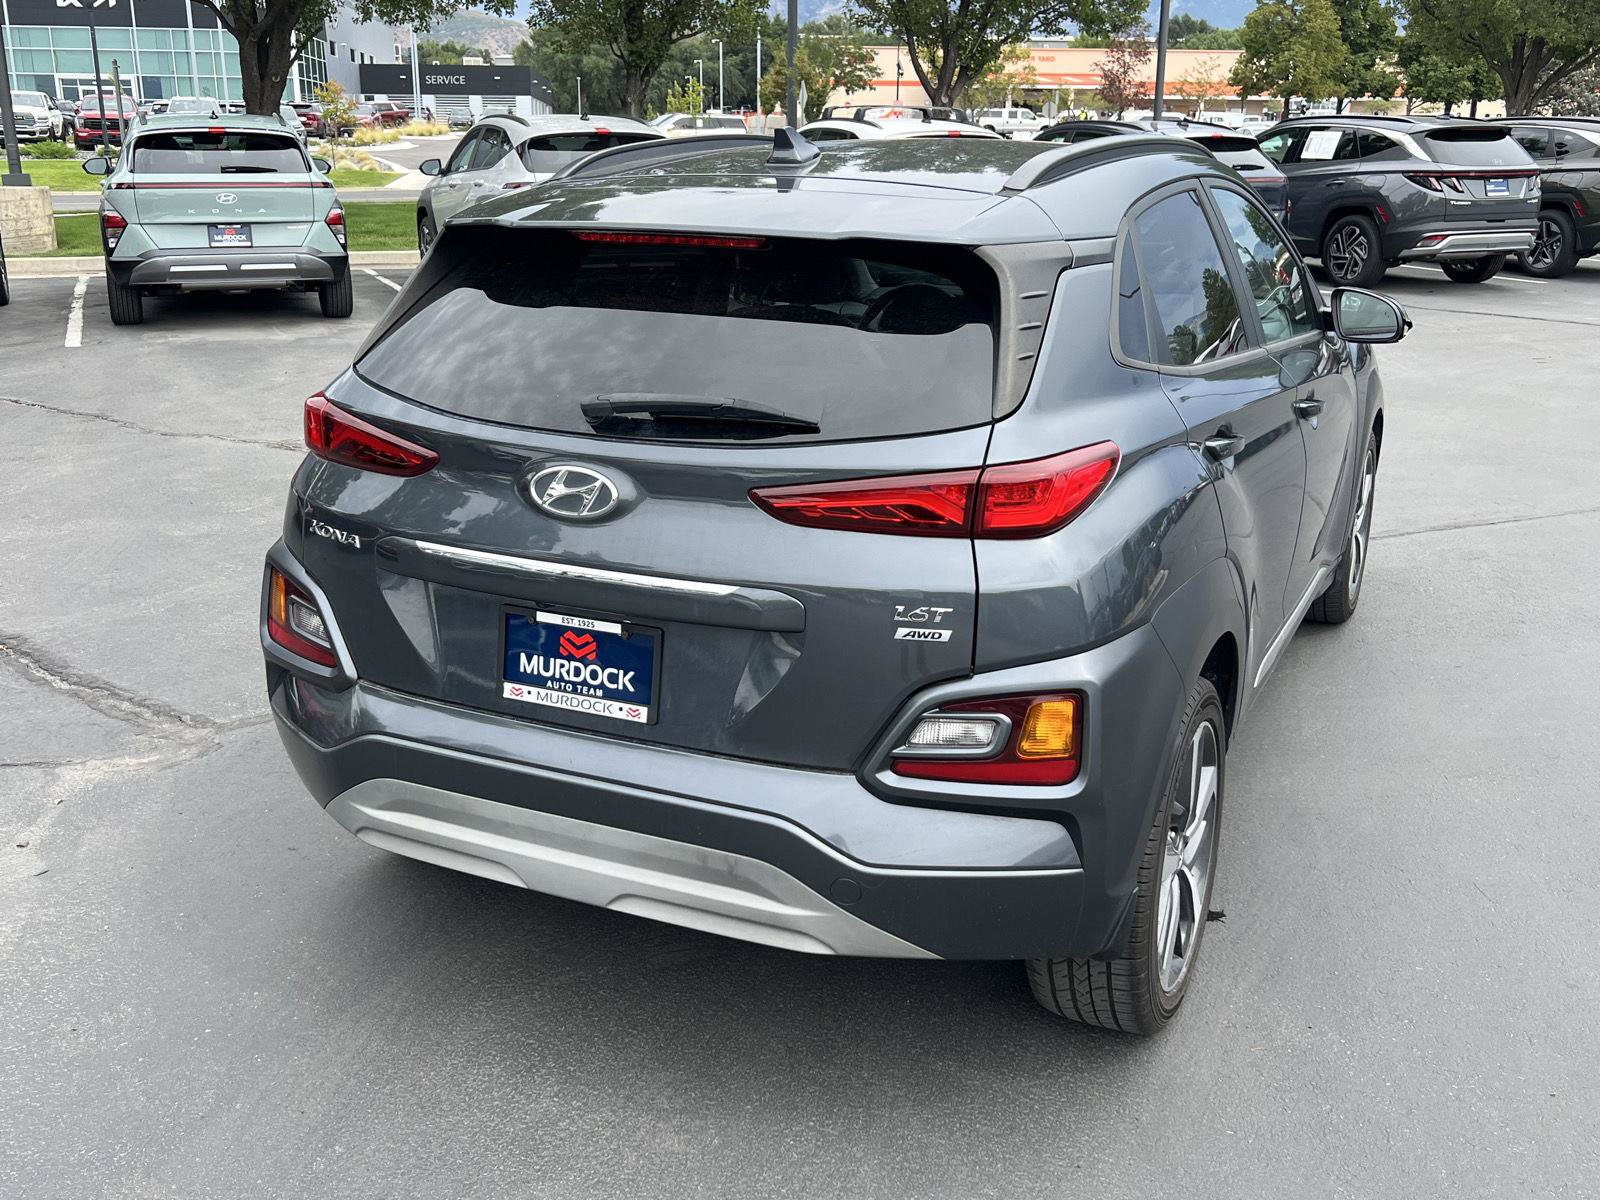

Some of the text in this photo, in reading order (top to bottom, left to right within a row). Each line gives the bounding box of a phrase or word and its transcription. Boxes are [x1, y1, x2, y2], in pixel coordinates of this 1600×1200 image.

[425, 75, 466, 85] SERVICE
[310, 519, 361, 549] KONA
[561, 616, 595, 628] EST. 1925
[902, 630, 942, 639] AWD
[519, 652, 635, 692] MURDOCK
[546, 679, 603, 697] AUTO TEAM
[536, 690, 614, 714] MURDOCK
